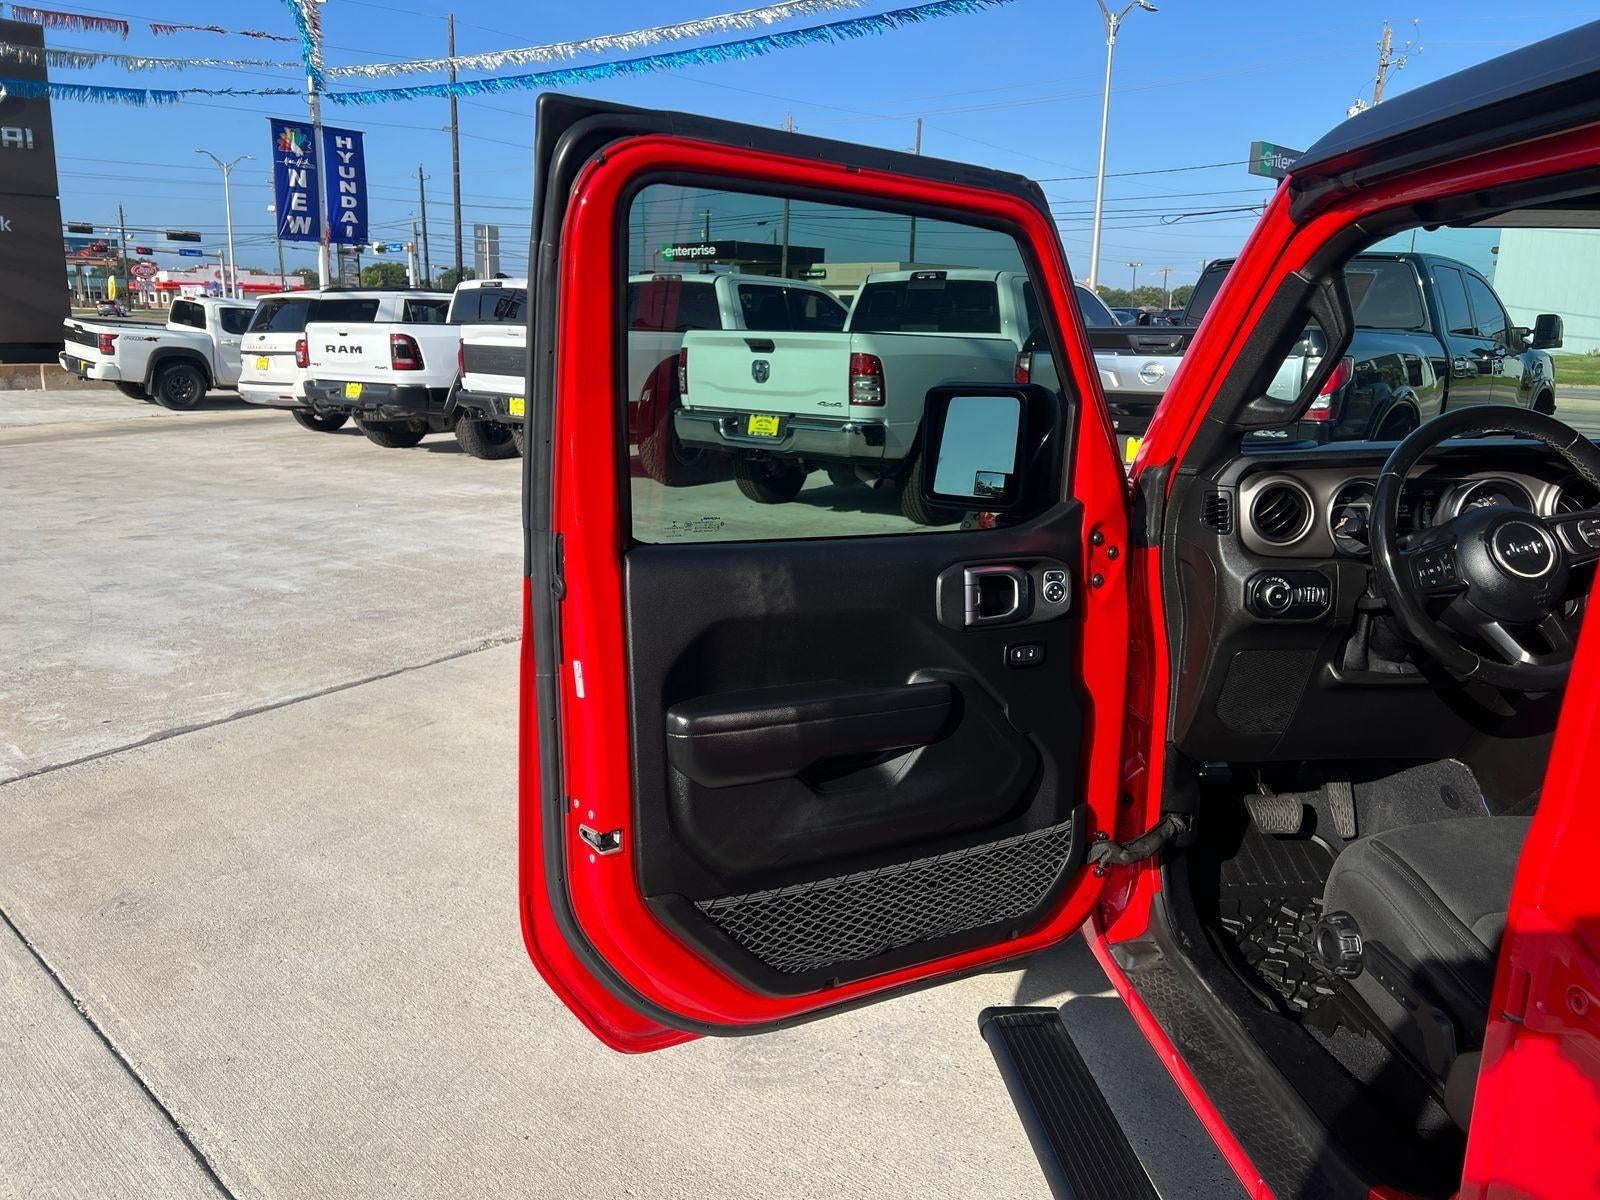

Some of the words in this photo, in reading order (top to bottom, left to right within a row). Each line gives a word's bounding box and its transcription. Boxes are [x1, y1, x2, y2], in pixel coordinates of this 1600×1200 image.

[286, 168, 312, 235] NEW
[335, 135, 358, 237] HYUNDAI
[663, 245, 716, 258] enterprise
[325, 345, 363, 354] RAM
